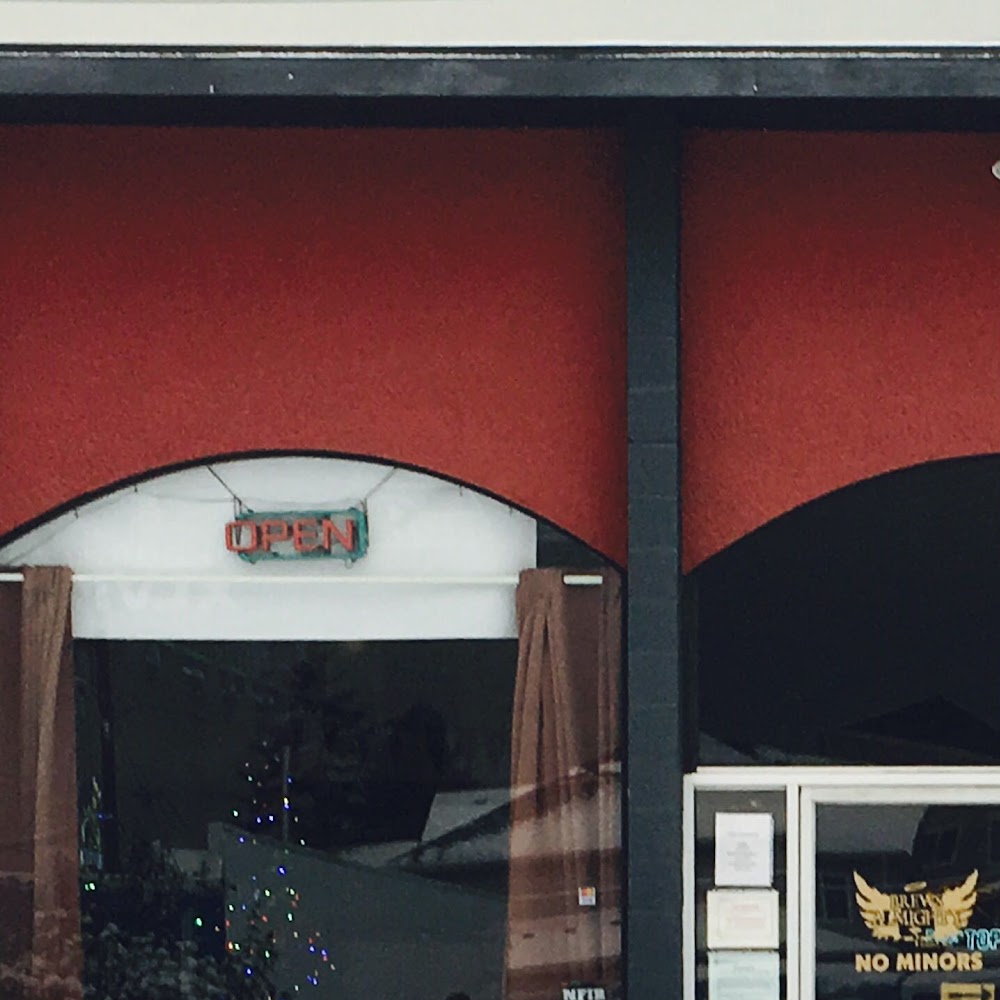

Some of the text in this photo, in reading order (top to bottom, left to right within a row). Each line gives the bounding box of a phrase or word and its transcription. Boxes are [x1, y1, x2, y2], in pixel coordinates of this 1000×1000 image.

[225, 518, 355, 553] OPEN
[855, 951, 983, 973] NO MINORS
